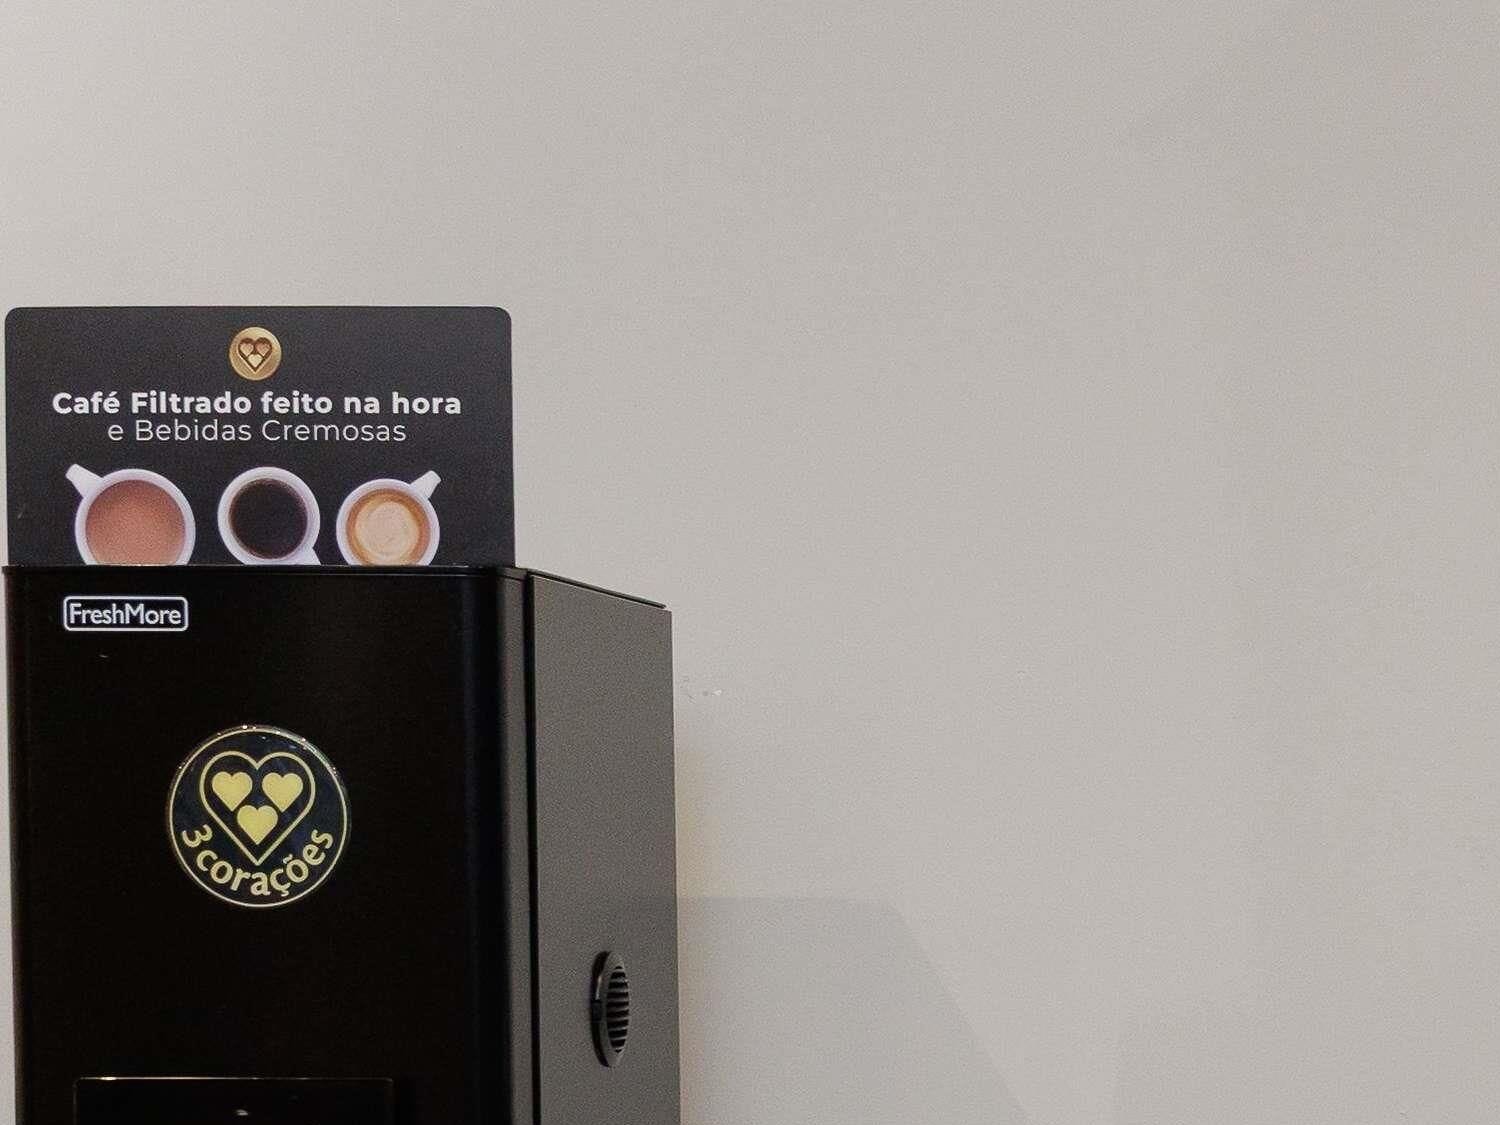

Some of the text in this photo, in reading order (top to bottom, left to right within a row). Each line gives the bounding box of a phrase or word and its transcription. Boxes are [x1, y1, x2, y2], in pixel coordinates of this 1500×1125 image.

[52, 391, 461, 414] Café Filtrado feito na hora
[107, 419, 407, 442] e Bebidas Cremosas
[69, 603, 182, 625] FreshMore
[182, 824, 333, 896] 3 corações
